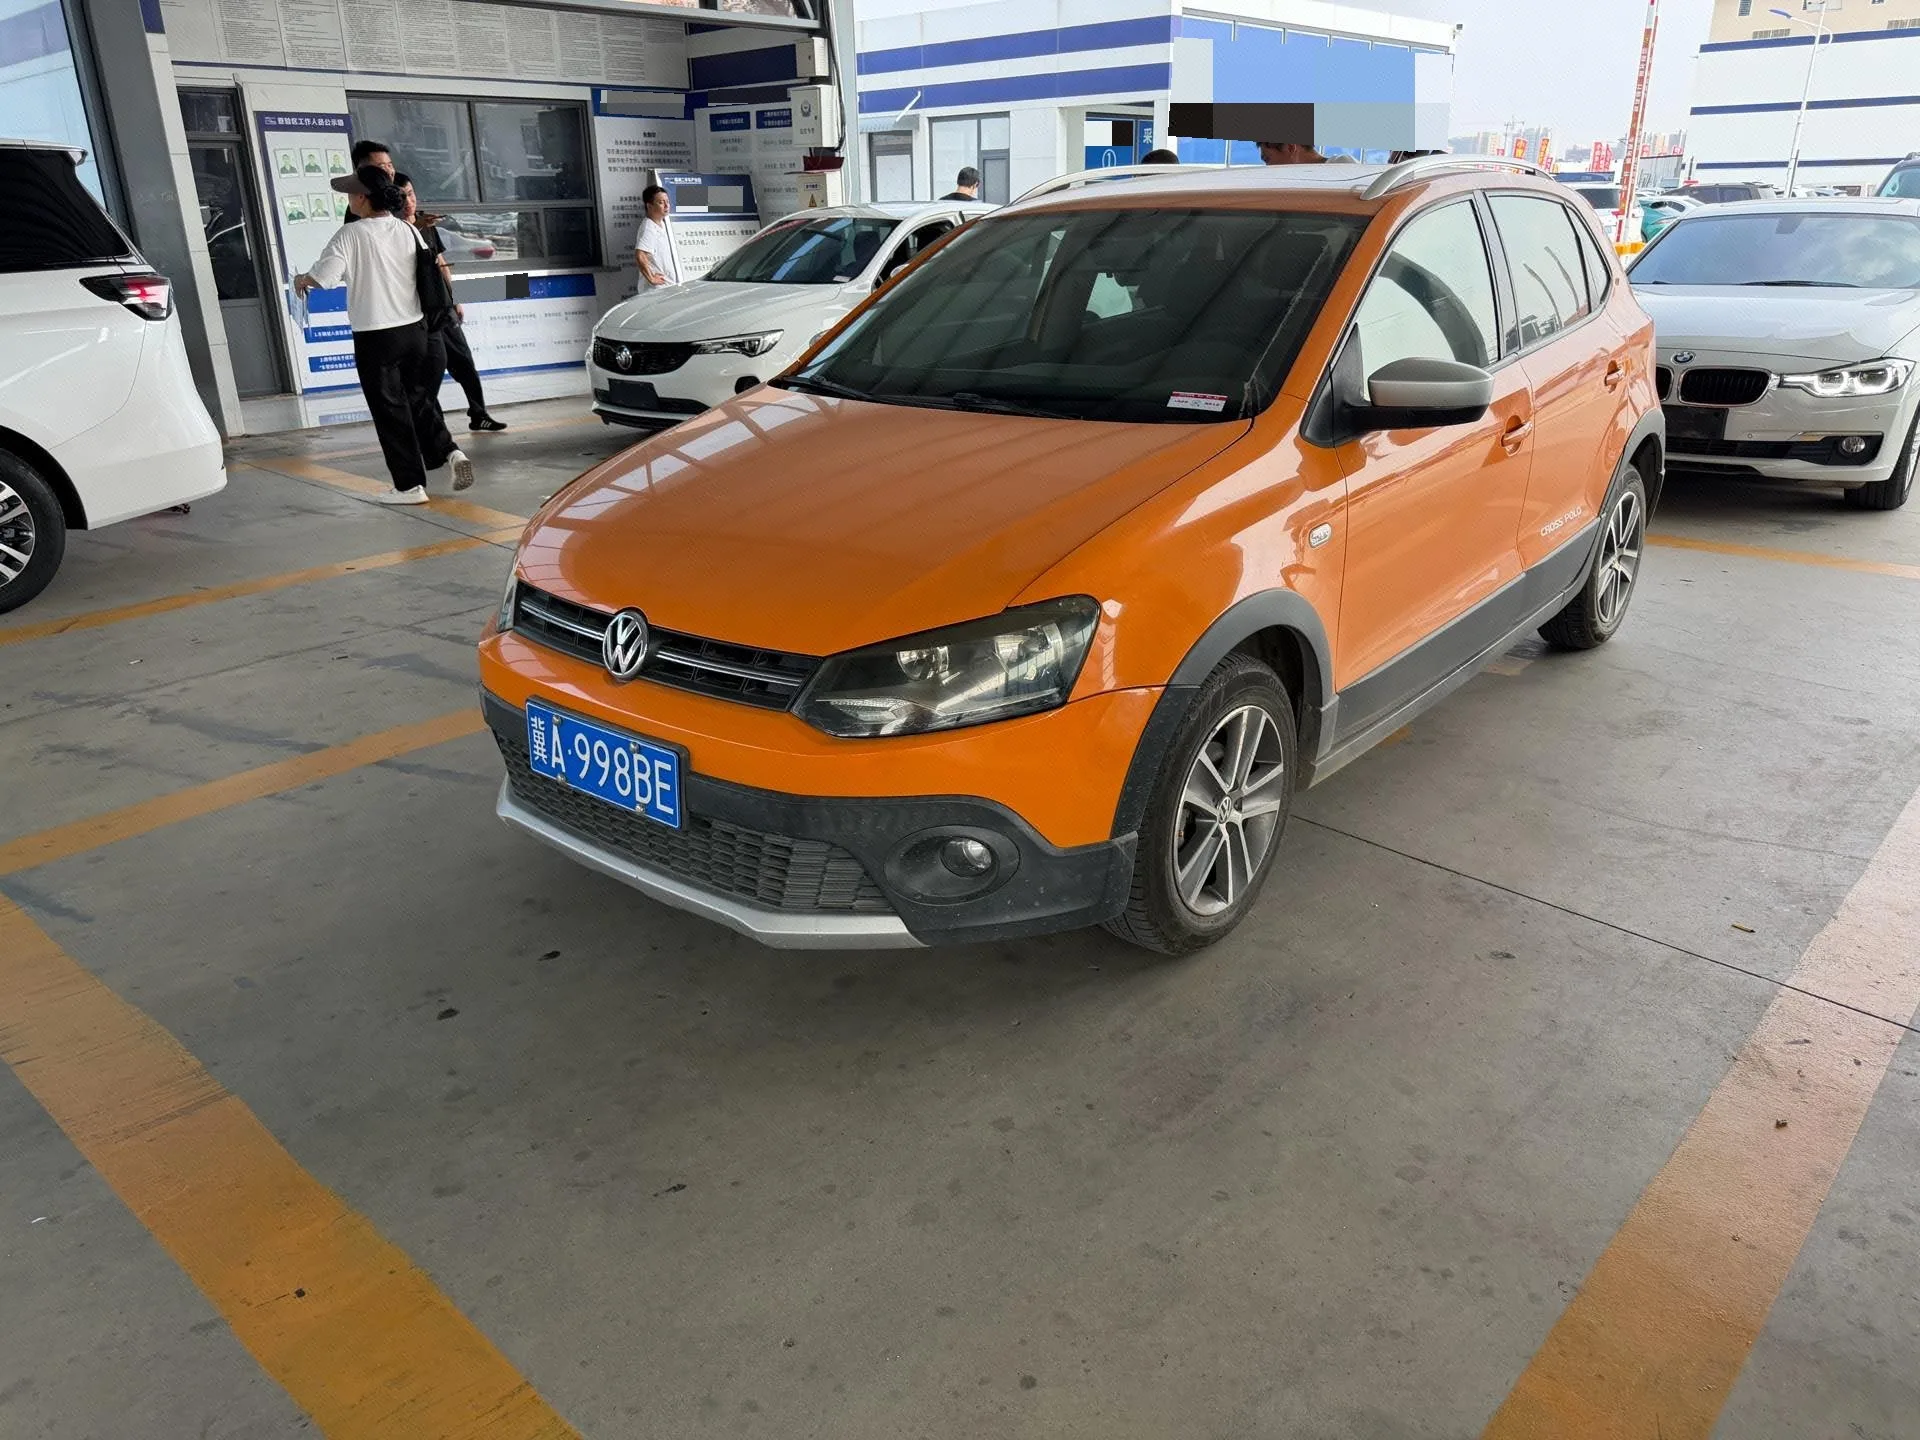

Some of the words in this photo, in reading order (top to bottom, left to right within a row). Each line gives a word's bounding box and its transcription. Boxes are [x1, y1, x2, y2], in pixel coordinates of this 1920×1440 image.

[1143, 128, 1153, 144] 采
[1540, 517, 1564, 537] CROSS
[1564, 506, 1582, 523] POLO
